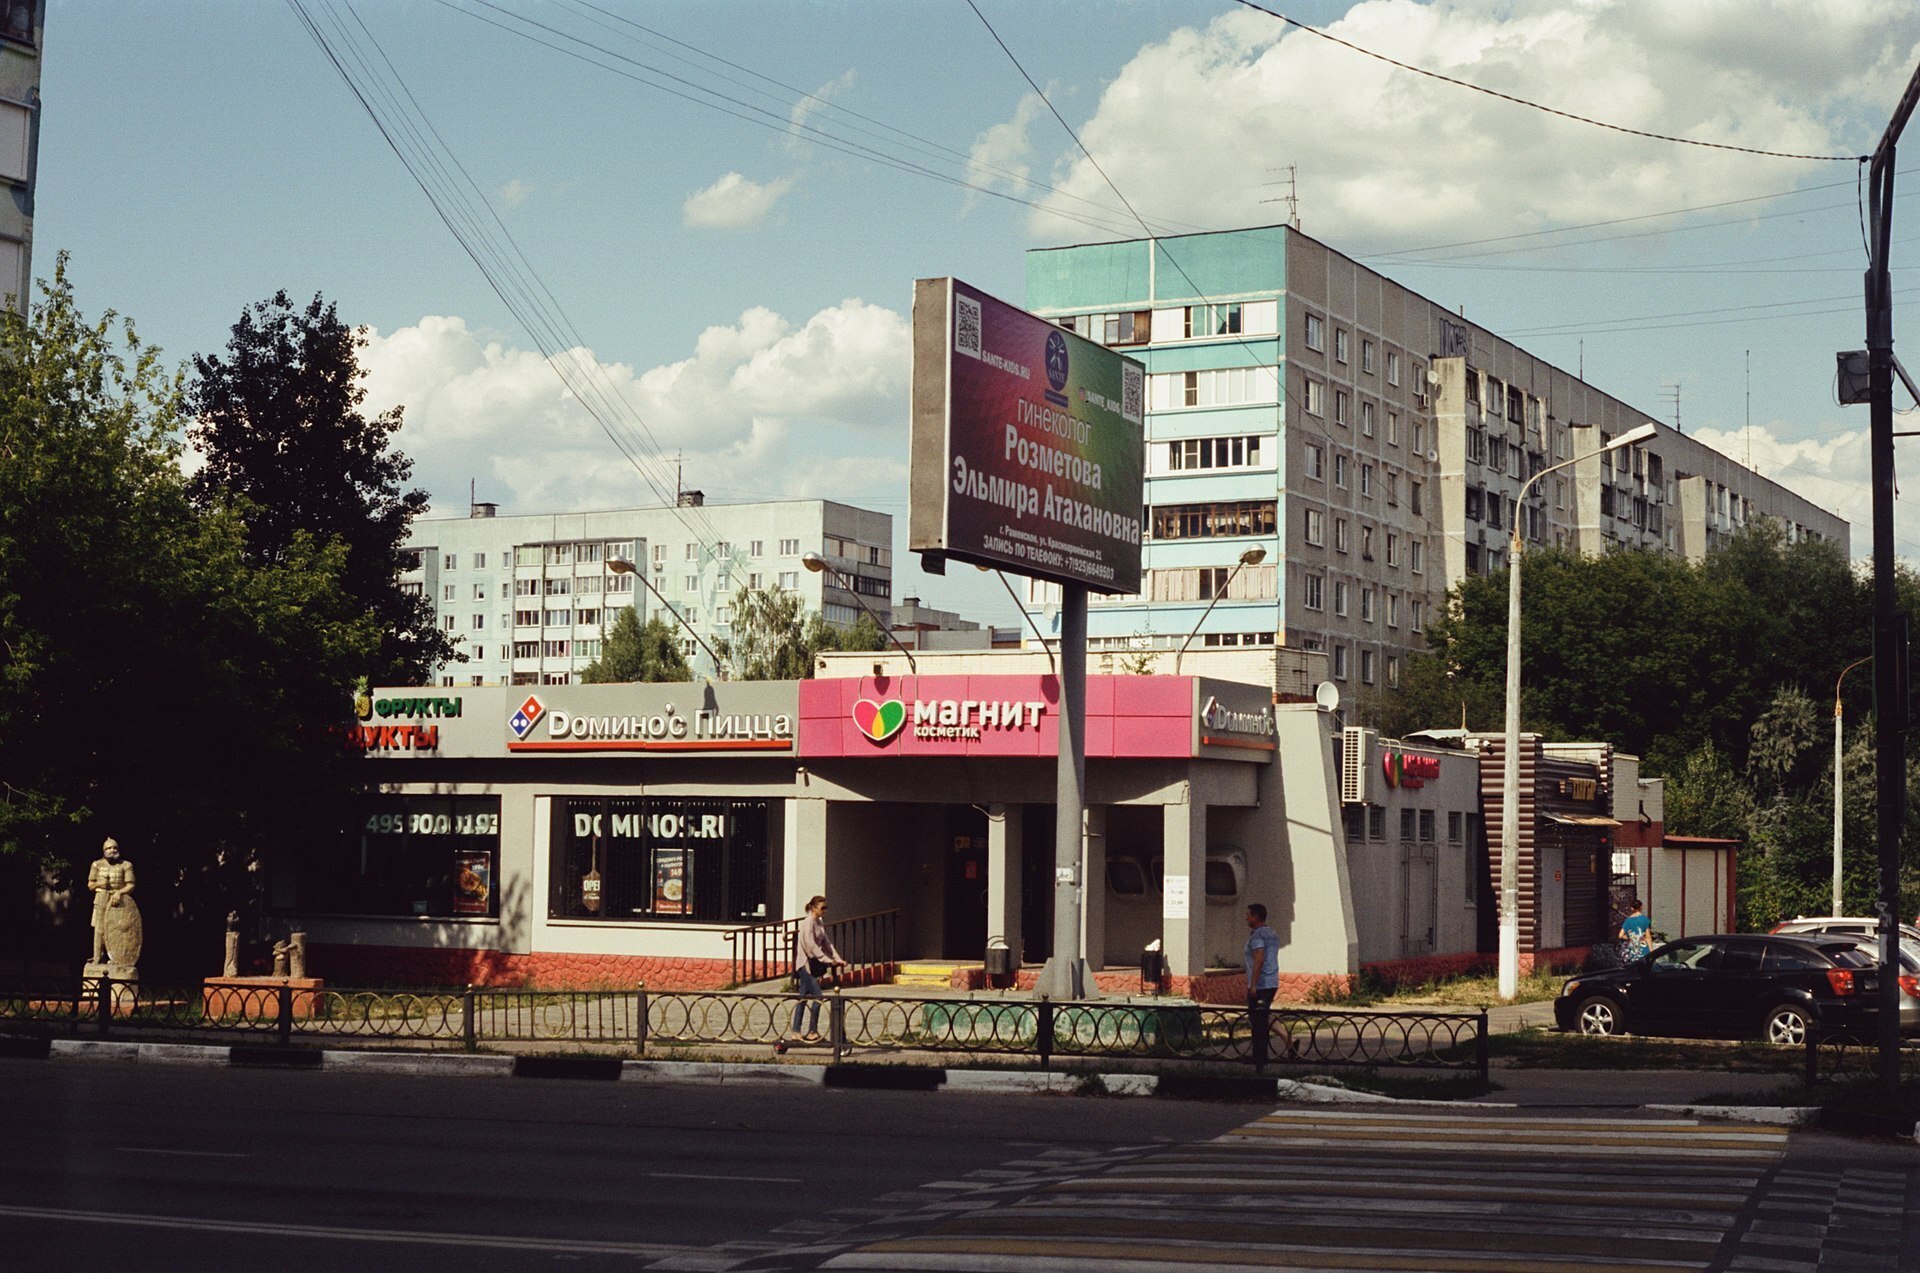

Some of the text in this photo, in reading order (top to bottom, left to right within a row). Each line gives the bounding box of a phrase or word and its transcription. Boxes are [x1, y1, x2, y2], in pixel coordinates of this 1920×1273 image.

[982, 350, 1030, 380] SANTE-KIDS.RU
[1005, 423, 1101, 490] Розметова
[953, 455, 1140, 545] Эльмира Атахановна
[983, 535, 1014, 555] ЗАПИСЬ
[1014, 543, 1026, 558] ПО
[1026, 546, 1064, 568] ТЕЛЕФОНУ:
[374, 696, 463, 719] ФРУКТЫ
[694, 709, 792, 742] Пицца
